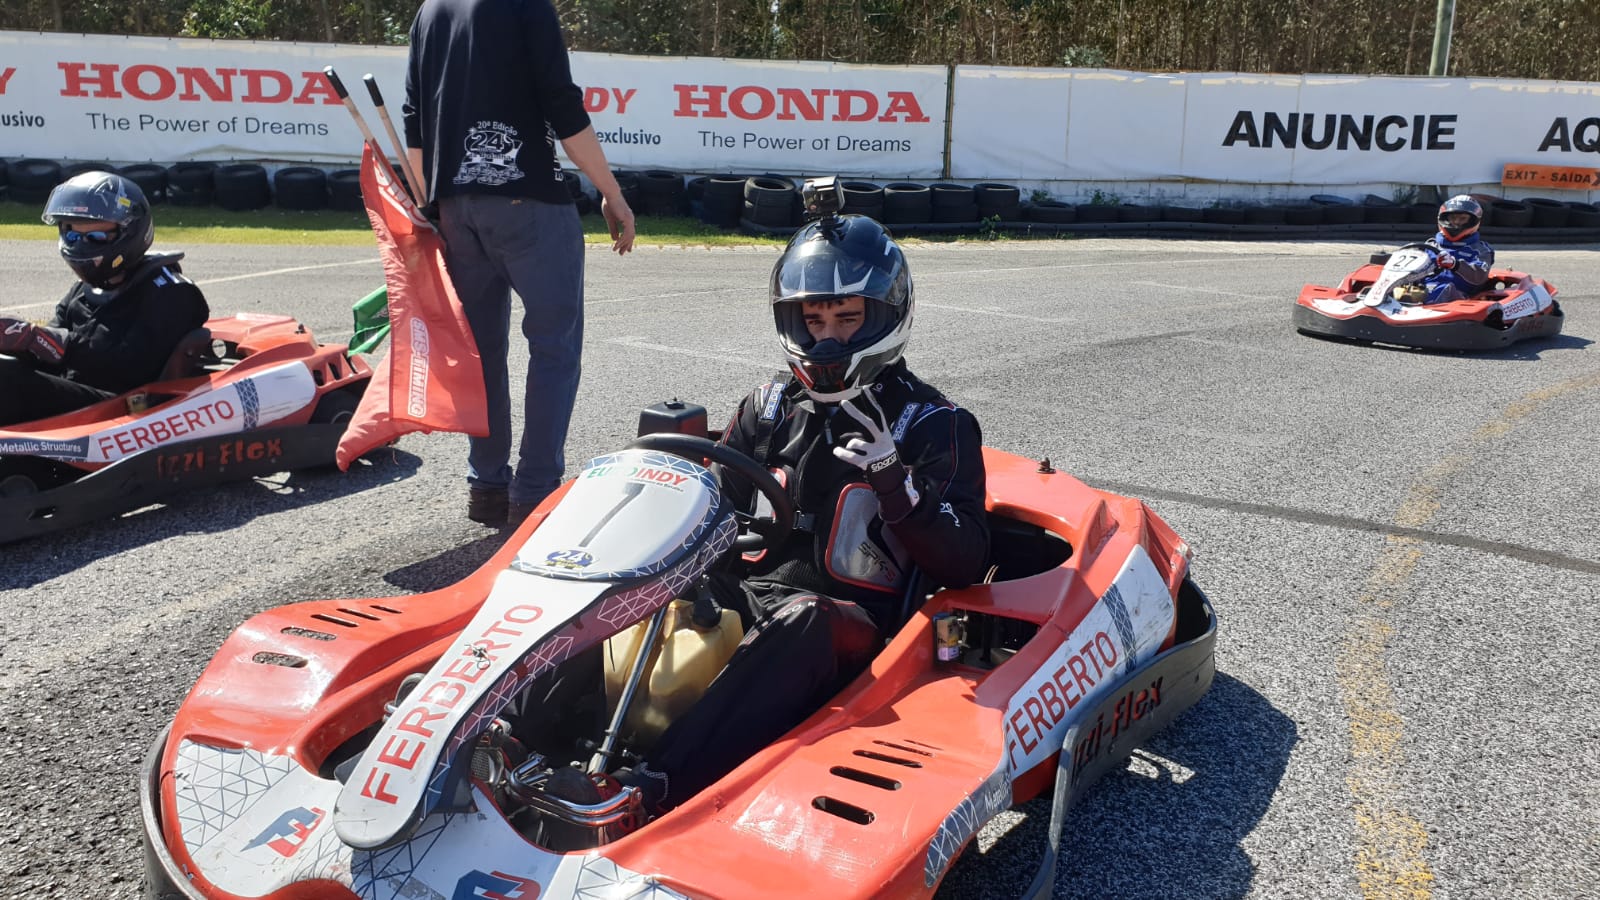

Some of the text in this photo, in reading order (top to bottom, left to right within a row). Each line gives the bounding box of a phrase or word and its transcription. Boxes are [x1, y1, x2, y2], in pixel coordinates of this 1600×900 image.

[57, 61, 346, 106] HONDA
[673, 84, 931, 123] HONDA
[1, 110, 45, 128] usivo
[85, 112, 329, 137] The Power of Dreams
[492, 121, 518, 136] Edição
[469, 131, 505, 153] 24
[596, 127, 661, 146] exclusivo
[698, 130, 911, 152] The Power of Dreams
[1221, 110, 1600, 152] ANUNCIE AQ
[1505, 169, 1538, 180] EXIT
[1551, 171, 1591, 184] SAÍDA
[1393, 255, 1418, 267] 27
[98, 400, 235, 460] FERBERTO
[0, 441, 82, 453] Metallic Structures
[587, 466, 689, 486] EUINDY
[360, 604, 544, 805] FERBERTO
[1005, 630, 1118, 771] FERBERTO
